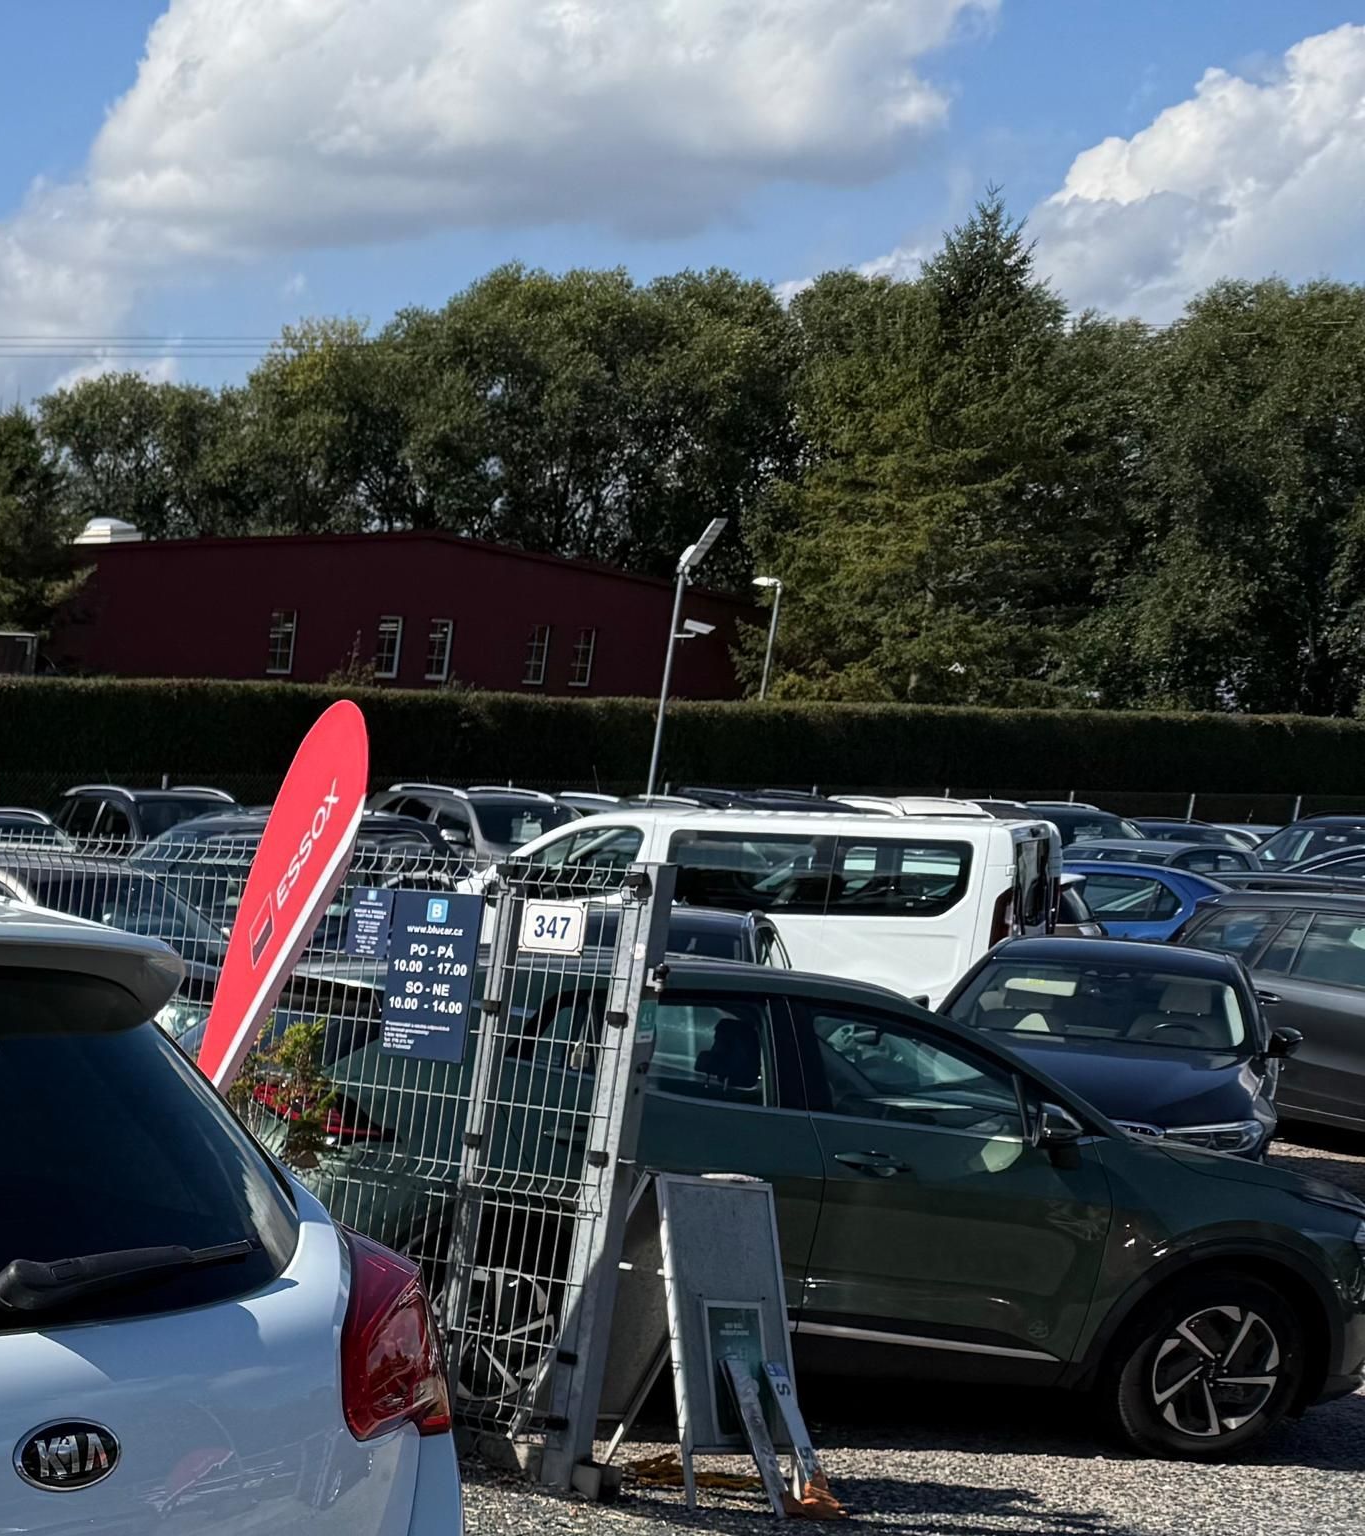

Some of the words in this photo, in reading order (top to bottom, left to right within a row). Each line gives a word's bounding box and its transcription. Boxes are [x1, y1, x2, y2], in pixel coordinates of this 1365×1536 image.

[276, 777, 340, 911] ESSOX
[406, 924, 464, 937] www.blucar.cz
[534, 914, 571, 940] 347
[410, 943, 428, 957] PO
[437, 943, 455, 959] PÁ
[393, 958, 423, 973] 10.00
[437, 962, 468, 977] 17.00
[405, 980, 423, 994] SO
[432, 983, 450, 997] NE
[388, 995, 418, 1010] 10.00
[432, 1000, 463, 1014] 14.00
[34, 1432, 109, 1478] KIA
